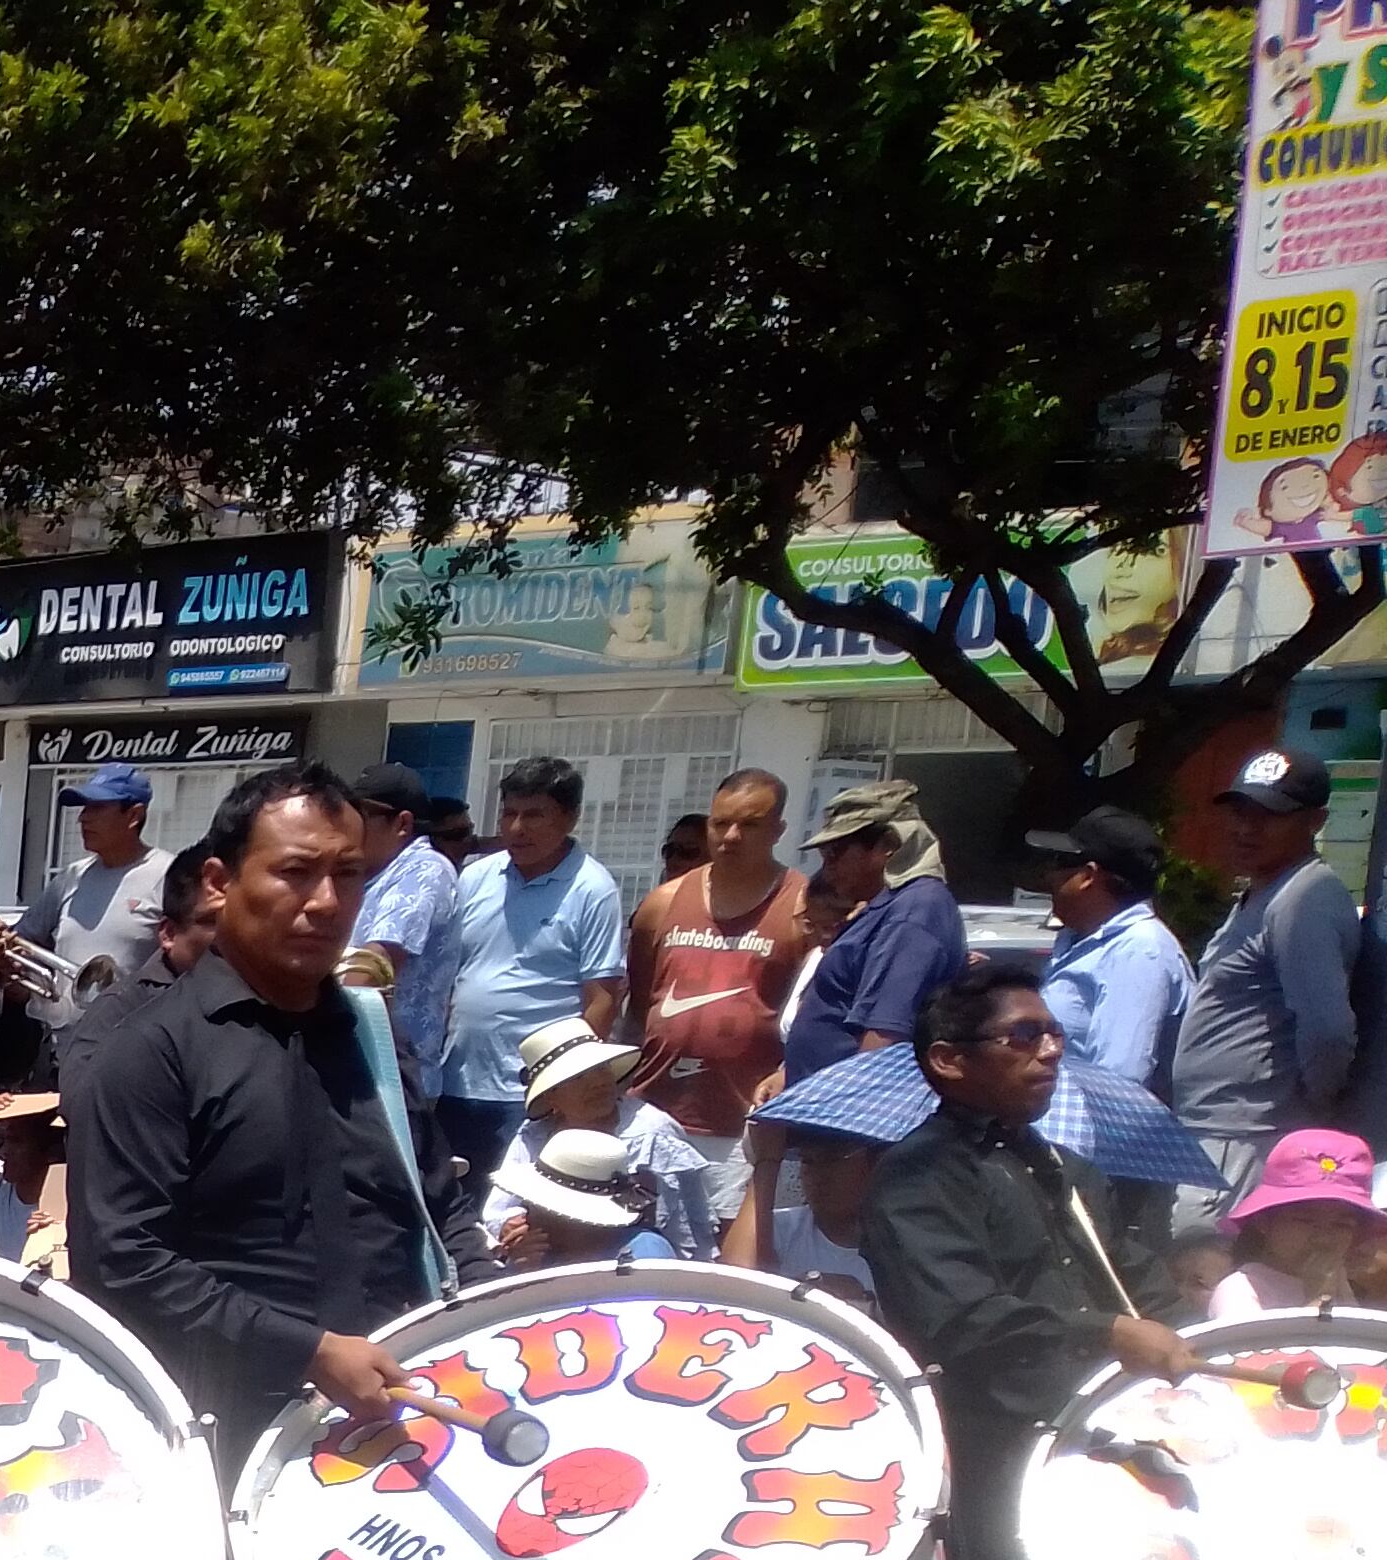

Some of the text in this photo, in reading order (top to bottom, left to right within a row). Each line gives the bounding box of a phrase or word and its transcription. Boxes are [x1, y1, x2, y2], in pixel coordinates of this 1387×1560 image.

[1257, 301, 1346, 339] INICIO
[1240, 346, 1276, 418] 8
[1295, 337, 1350, 412] 15
[1235, 423, 1341, 453] DE ENERO
[37, 555, 310, 636] DENTAL ZUÑIGA
[59, 634, 287, 664] CONSULTORIO ODONTOLOGICO
[422, 652, 524, 674] 931698527
[81, 724, 294, 761] Dental Zuñiga
[663, 925, 775, 957] skateboarding
